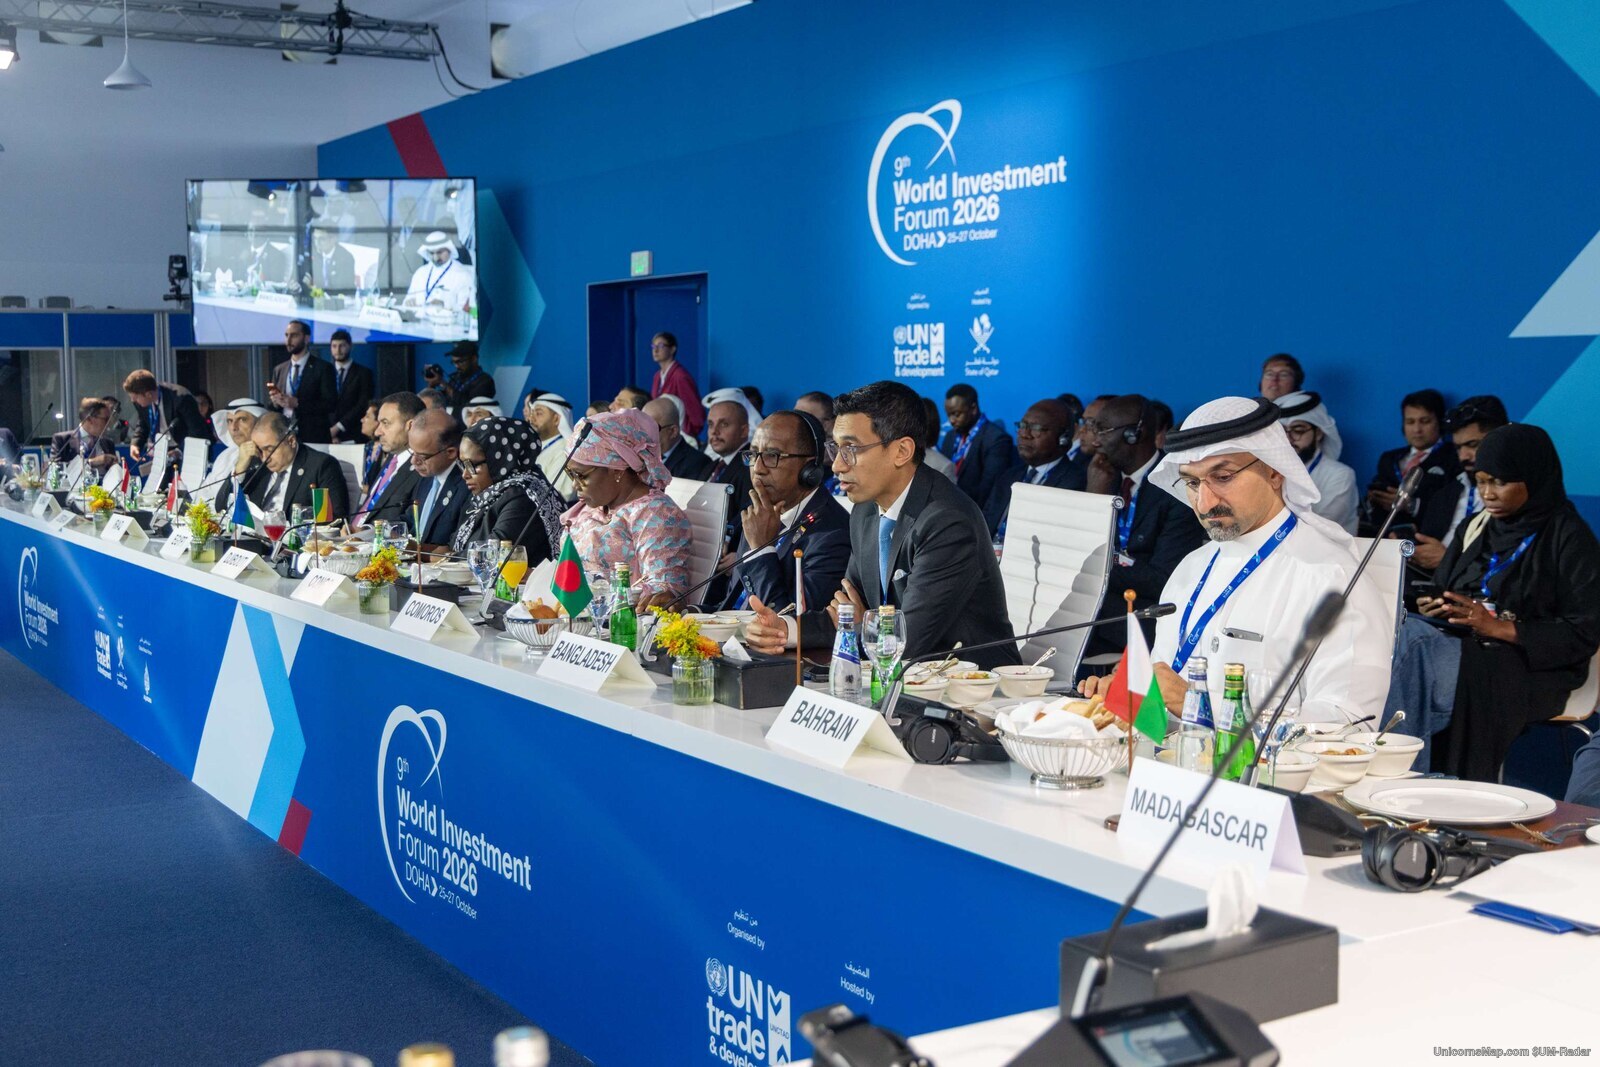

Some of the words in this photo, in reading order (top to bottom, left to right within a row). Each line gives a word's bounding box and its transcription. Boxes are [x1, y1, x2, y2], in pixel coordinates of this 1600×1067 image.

[893, 155, 911, 178] 9th
[893, 173, 947, 205] World
[952, 155, 1067, 198] Investment
[894, 206, 949, 232] Forum
[952, 194, 1000, 226] 2026
[903, 232, 938, 251] DOHA
[907, 323, 929, 345] UN
[893, 345, 929, 366] trade
[404, 599, 446, 625] COMOROS
[550, 639, 618, 673] BANGLADESH
[789, 699, 859, 742] BAHRAIN
[396, 756, 410, 781] 9th
[1130, 787, 1268, 851] MADAGASCAR
[396, 784, 437, 837] World
[440, 808, 532, 891] Investment
[398, 819, 440, 873] Forum
[442, 847, 478, 896] 2026
[405, 861, 432, 895] DOHA
[439, 885, 455, 904] 25-27
[455, 895, 478, 920] October
[727, 921, 756, 945] Organised
[757, 936, 766, 951] by
[728, 964, 764, 1020] UN
[840, 976, 865, 998] Hosted
[865, 988, 875, 1005] by
[706, 995, 766, 1061] trade
[709, 1035, 718, 1056] &
